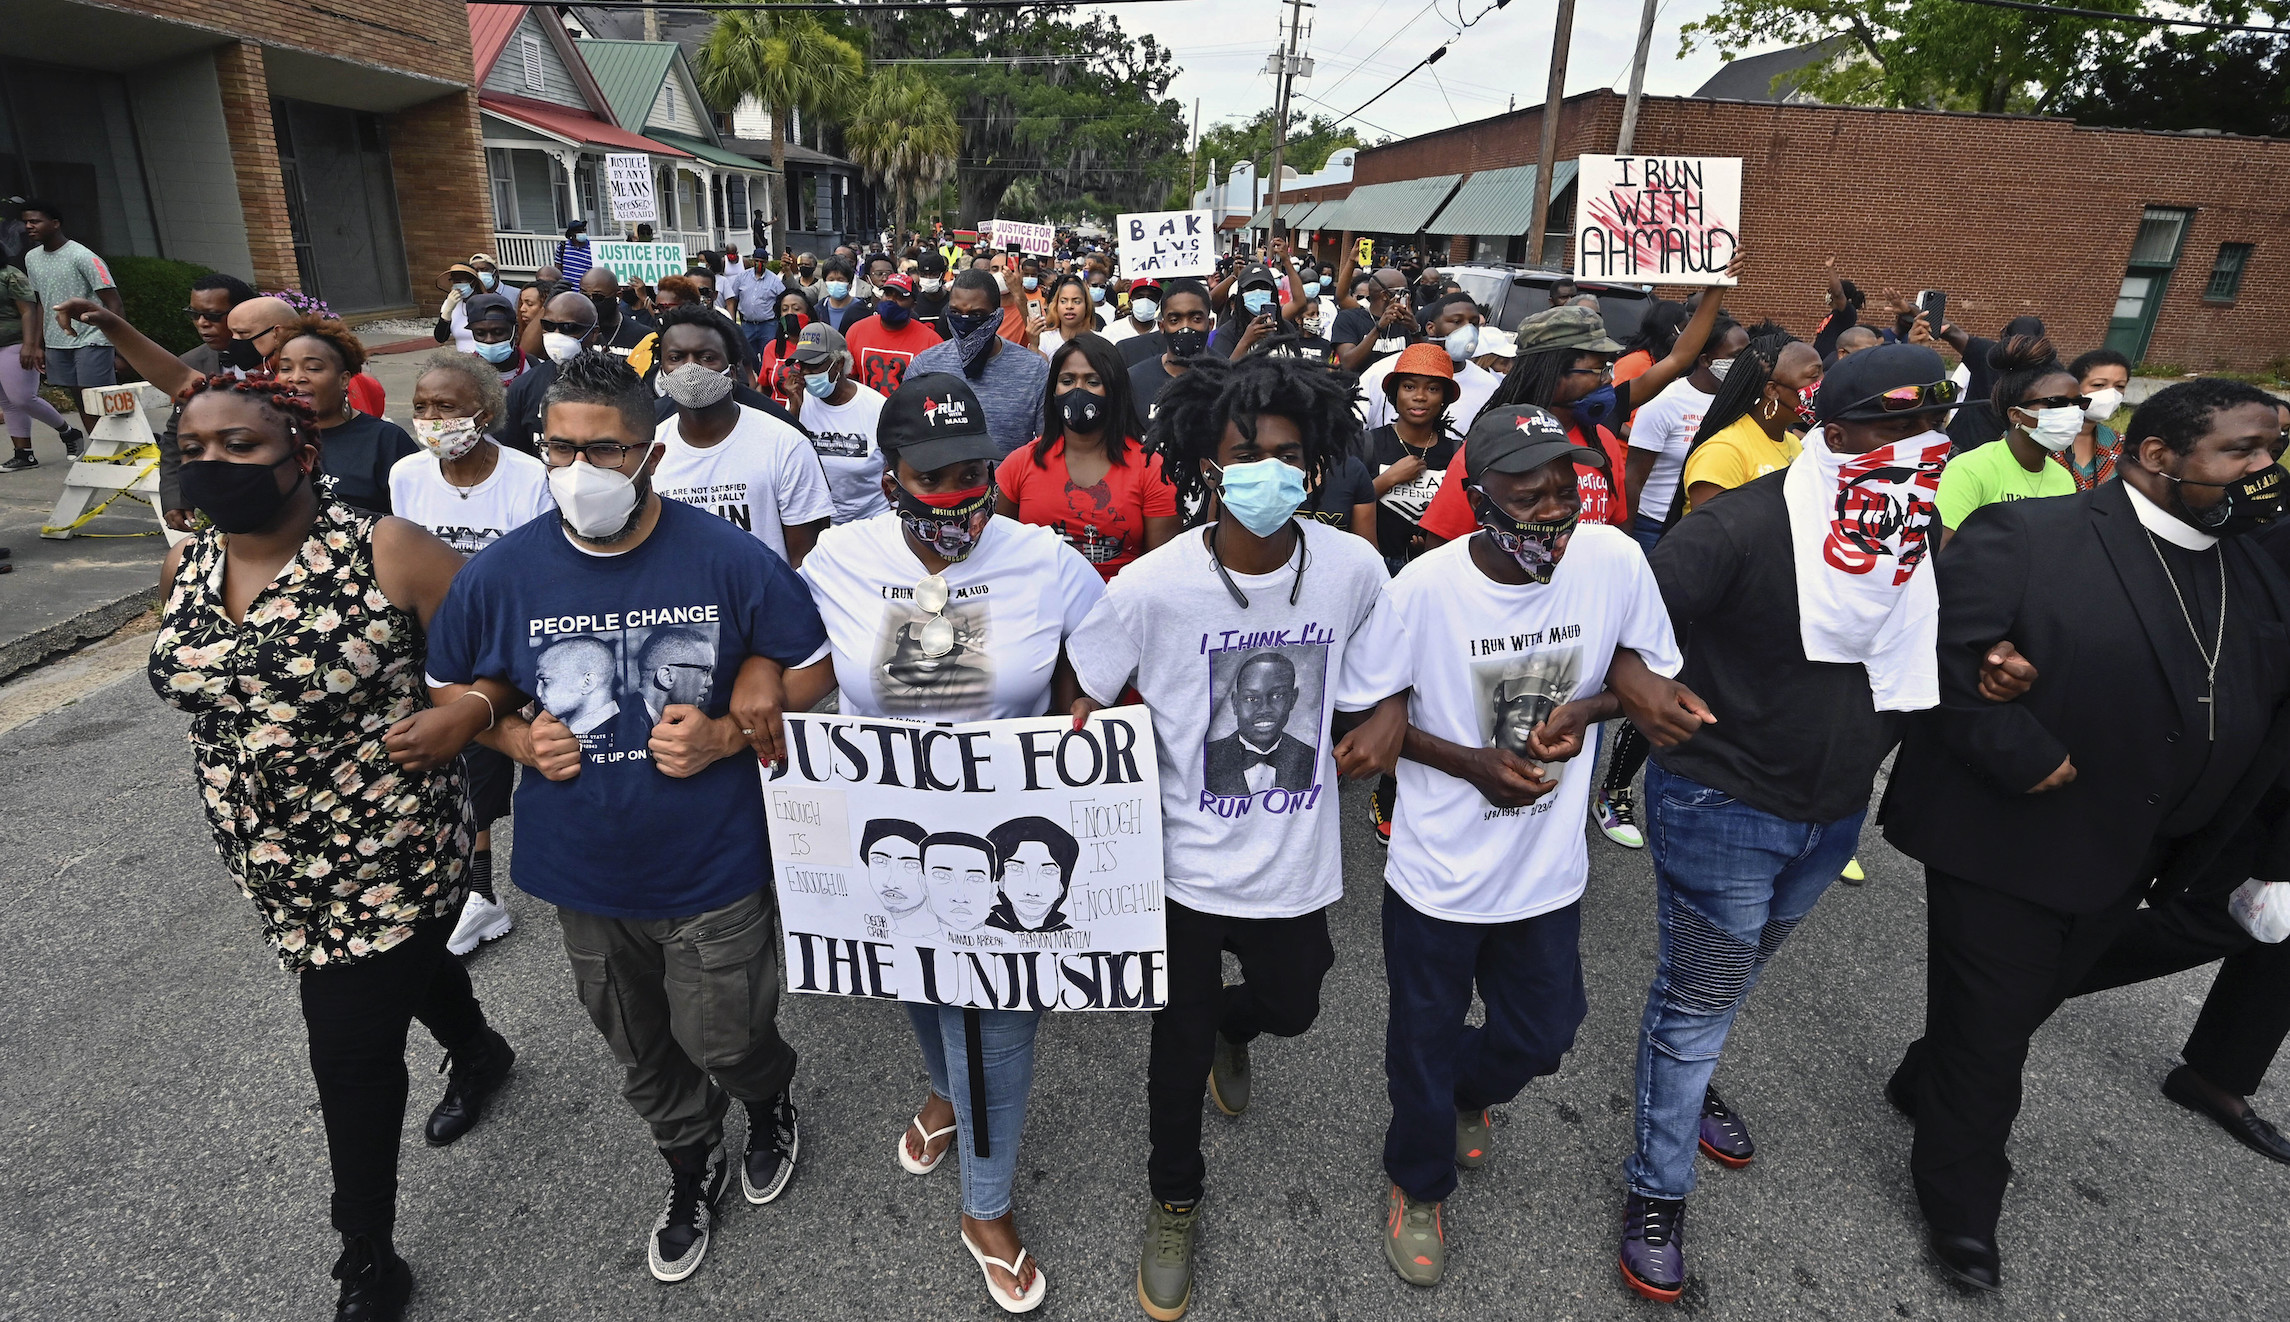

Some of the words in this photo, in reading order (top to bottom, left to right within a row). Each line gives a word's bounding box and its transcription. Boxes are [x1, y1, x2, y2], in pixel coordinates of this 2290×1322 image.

[608, 156, 647, 168] JUSTICE!
[614, 170, 624, 180] BY
[626, 170, 648, 180] ANY
[1614, 158, 1637, 186] I
[1645, 158, 1703, 190] RUN
[611, 181, 650, 198] MEANS
[617, 211, 654, 219] AHMAUD
[1610, 189, 1703, 226] WITH
[996, 222, 1032, 236] JUSTICE
[1034, 227, 1052, 238] FOR
[598, 244, 652, 261] JUSTICE
[656, 246, 682, 261] FOR
[1581, 226, 1736, 276] AHMAUD
[103, 392, 134, 413] COB
[938, 400, 966, 414] RUN
[946, 393, 952, 402] I
[944, 417, 968, 425] MAUD
[672, 488, 688, 496] ARE
[690, 486, 708, 494] NOT
[710, 483, 747, 492] SATISFIED
[711, 494, 716, 502] &
[718, 492, 746, 502] RALLY
[1597, 492, 1608, 514] it
[450, 542, 472, 550] WITH
[891, 587, 914, 599] RUN
[956, 584, 989, 599] MAUD
[529, 613, 620, 636] PEOPLE
[626, 604, 720, 628] CHANGE
[1200, 633, 1208, 655] I
[1220, 630, 1290, 653] THINK
[1470, 640, 1476, 656] I
[1481, 638, 1505, 655] RUN
[1548, 624, 1581, 645] MAUD
[608, 751, 625, 762] UP
[628, 749, 647, 760] ON
[768, 718, 996, 793] JUSTICE
[1016, 718, 1144, 792] FOR
[772, 790, 820, 826] ENOUGH
[1199, 790, 1253, 818] RUN
[1070, 798, 1142, 838] ENOUGH
[789, 833, 811, 855] IS
[1090, 840, 1118, 874] IS
[785, 866, 848, 897] ENOUGH!!!
[1070, 880, 1160, 922] ENOUGH!!!
[789, 931, 898, 1000] THE
[914, 946, 1166, 1011] UNJUSTICE
